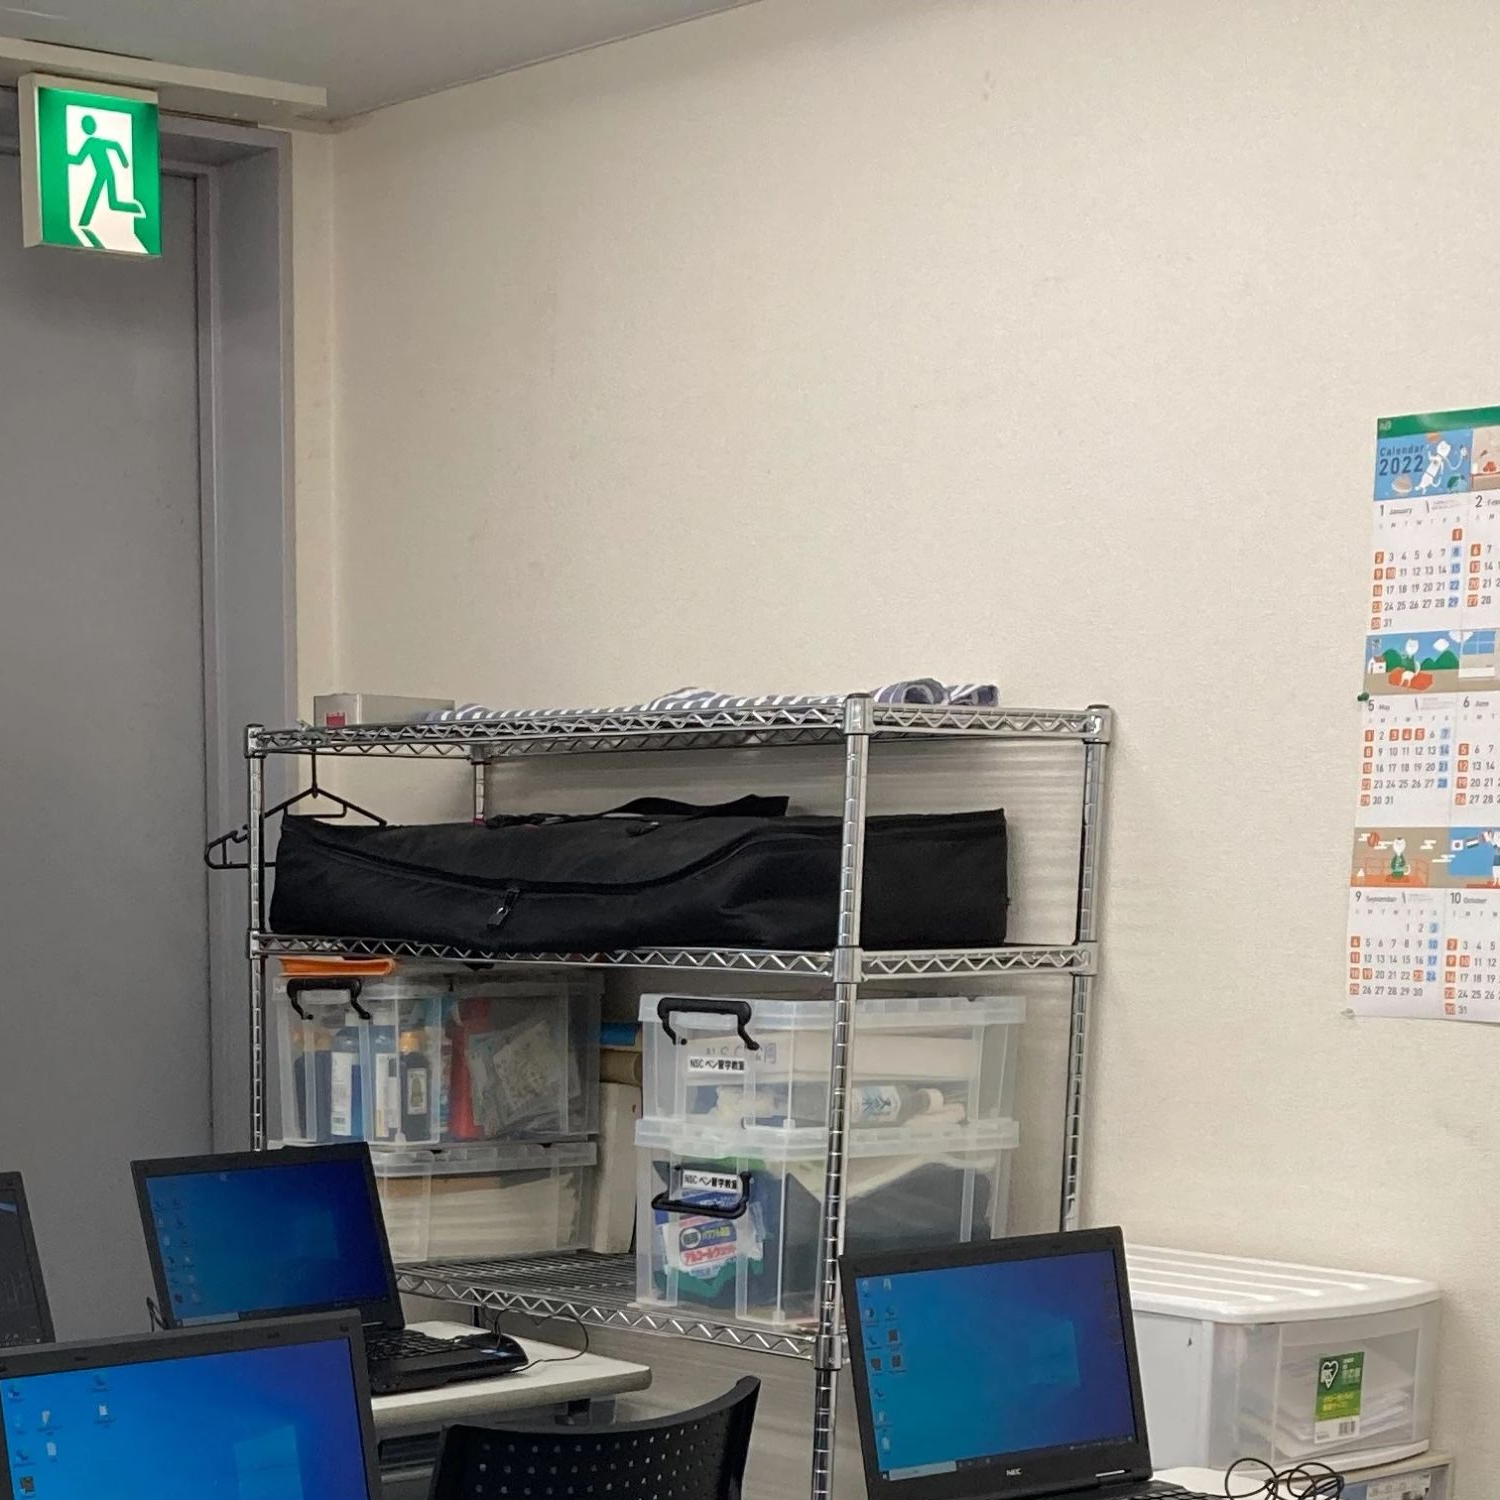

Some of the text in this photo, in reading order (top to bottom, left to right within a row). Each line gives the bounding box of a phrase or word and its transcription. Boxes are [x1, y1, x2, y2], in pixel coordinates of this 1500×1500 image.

[1380, 444, 1424, 457] Calendar
[1379, 455, 1424, 476] 2022
[1475, 495, 1483, 508] 2
[1380, 504, 1385, 516] 1
[1487, 544, 1492, 553] 7
[1389, 552, 1395, 562] 3
[1401, 552, 1407, 560] 4
[1414, 550, 1419, 560] 5
[1427, 549, 1432, 559] 6
[1441, 548, 1446, 556] 7
[1400, 568, 1407, 576] 11
[1413, 567, 1421, 576] 12
[1425, 566, 1433, 575] 13
[1438, 565, 1447, 573] 14
[1452, 563, 1460, 573] 15
[1485, 562, 1493, 570] 14
[1386, 585, 1394, 594] 17
[1399, 584, 1407, 593] 18
[1411, 584, 1419, 592] 19
[1423, 582, 1433, 592] 20
[1436, 582, 1445, 591] 21
[1450, 580, 1459, 590] 22
[1483, 579, 1491, 588] 21
[1384, 602, 1393, 611] 24
[1397, 601, 1406, 610] 25
[1409, 601, 1419, 609] 26
[1422, 600, 1432, 608] 27
[1435, 599, 1445, 607] 28
[1448, 597, 1458, 607] 29
[1481, 596, 1491, 604] 28
[1384, 619, 1392, 627] 31
[1368, 700, 1374, 711] 5
[1463, 696, 1470, 708] 6
[1380, 731, 1384, 740] 2
[1429, 730, 1435, 738] 6
[1378, 748, 1383, 756] 9
[1389, 747, 1398, 756] 10
[1402, 747, 1409, 755] 11
[1416, 747, 1423, 755] 12
[1428, 746, 1436, 755] 13
[1475, 745, 1480, 753] 6
[1489, 745, 1494, 753] 7
[1376, 764, 1383, 772] 16
[1389, 764, 1396, 772] 17
[1401, 763, 1409, 772] 18
[1414, 763, 1421, 772] 19
[1426, 763, 1435, 772] 20
[1472, 762, 1481, 770] 13
[1486, 762, 1495, 770] 14
[1374, 780, 1383, 788] 23
[1386, 780, 1395, 788] 24
[1399, 780, 1408, 788] 25
[1412, 779, 1421, 788] 26
[1424, 779, 1434, 788] 27
[1470, 779, 1480, 787] 20
[1484, 778, 1493, 787] 21
[1373, 796, 1382, 804] 30
[1385, 796, 1393, 804] 31
[1469, 795, 1479, 804] 27
[1483, 795, 1493, 804] 28
[1356, 891, 1361, 902] 9
[1450, 892, 1461, 904] 10
[1418, 924, 1423, 932] 2
[1366, 938, 1370, 947] 5
[1378, 939, 1383, 947] 6
[1391, 939, 1396, 948] 7
[1404, 939, 1409, 948] 8
[1418, 940, 1422, 948] 9
[1429, 939, 1437, 949] 10
[1463, 941, 1468, 950] 3
[1476, 941, 1481, 950] 4
[1490, 942, 1495, 950] 5
[1364, 954, 1372, 963] 12
[1377, 954, 1385, 963] 13
[1389, 955, 1397, 963] 14
[1403, 955, 1410, 964] 15
[1415, 956, 1423, 964] 16
[1428, 955, 1437, 965] 17
[1474, 958, 1481, 966] 11
[1488, 958, 1496, 967] 12
[1375, 970, 1384, 979] 20
[1388, 971, 1396, 979] 21
[1401, 971, 1410, 980] 22
[1460, 974, 1468, 982] 17
[1473, 974, 1482, 982] 18
[1487, 974, 1495, 983] 19
[1363, 986, 1423, 996] 26 27 28 29 30
[1458, 990, 1494, 1000] 24 25 26
[1458, 1006, 1467, 1014] 31
[690, 1059, 704, 1069] NSC
[1006, 1467, 1022, 1476] NEC
